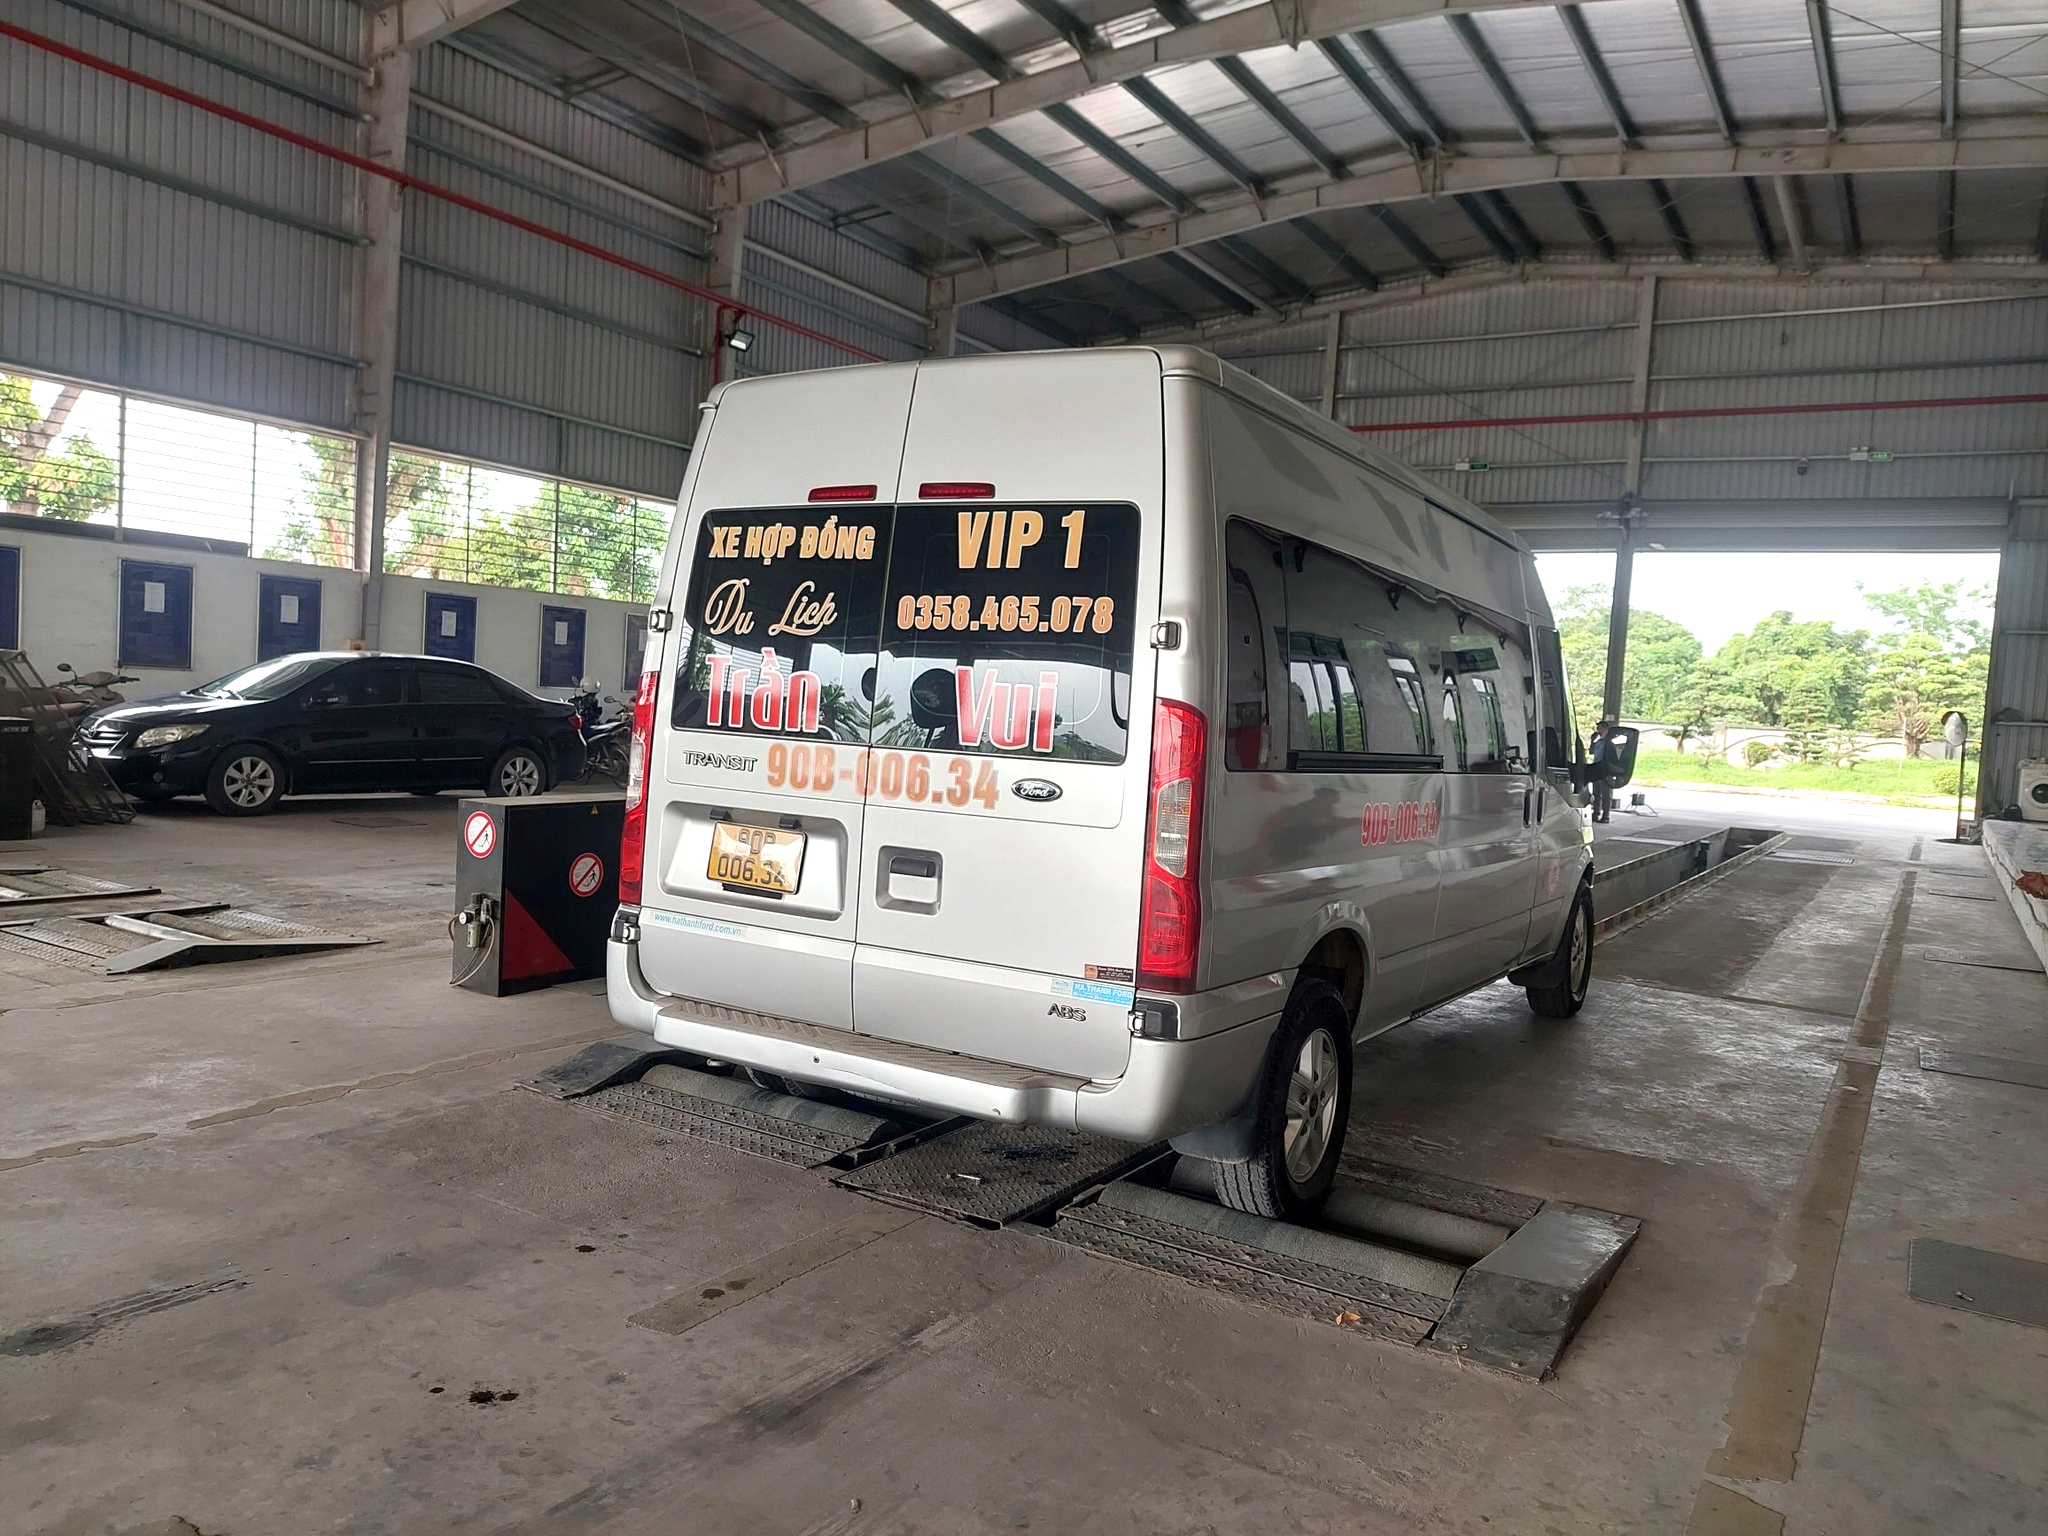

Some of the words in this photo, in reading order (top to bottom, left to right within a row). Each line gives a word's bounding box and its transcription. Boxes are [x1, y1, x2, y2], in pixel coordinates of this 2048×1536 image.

[708, 526, 743, 559] XE
[744, 522, 797, 566] HỢP
[799, 515, 876, 561] ĐỒNG
[958, 510, 1044, 569] VIP
[1061, 510, 1086, 569] 1
[705, 578, 755, 636] Du
[896, 594, 1115, 635] 0358.465.078
[705, 647, 822, 734] Trần
[955, 665, 1060, 753] Vui
[684, 750, 758, 773] TRANSIT
[766, 742, 999, 811] 90B-006.34
[1361, 800, 1437, 847] 90B-006.34
[654, 912, 742, 937] www.hathanhford.com.vn
[1047, 1003, 1088, 1022] ABS
